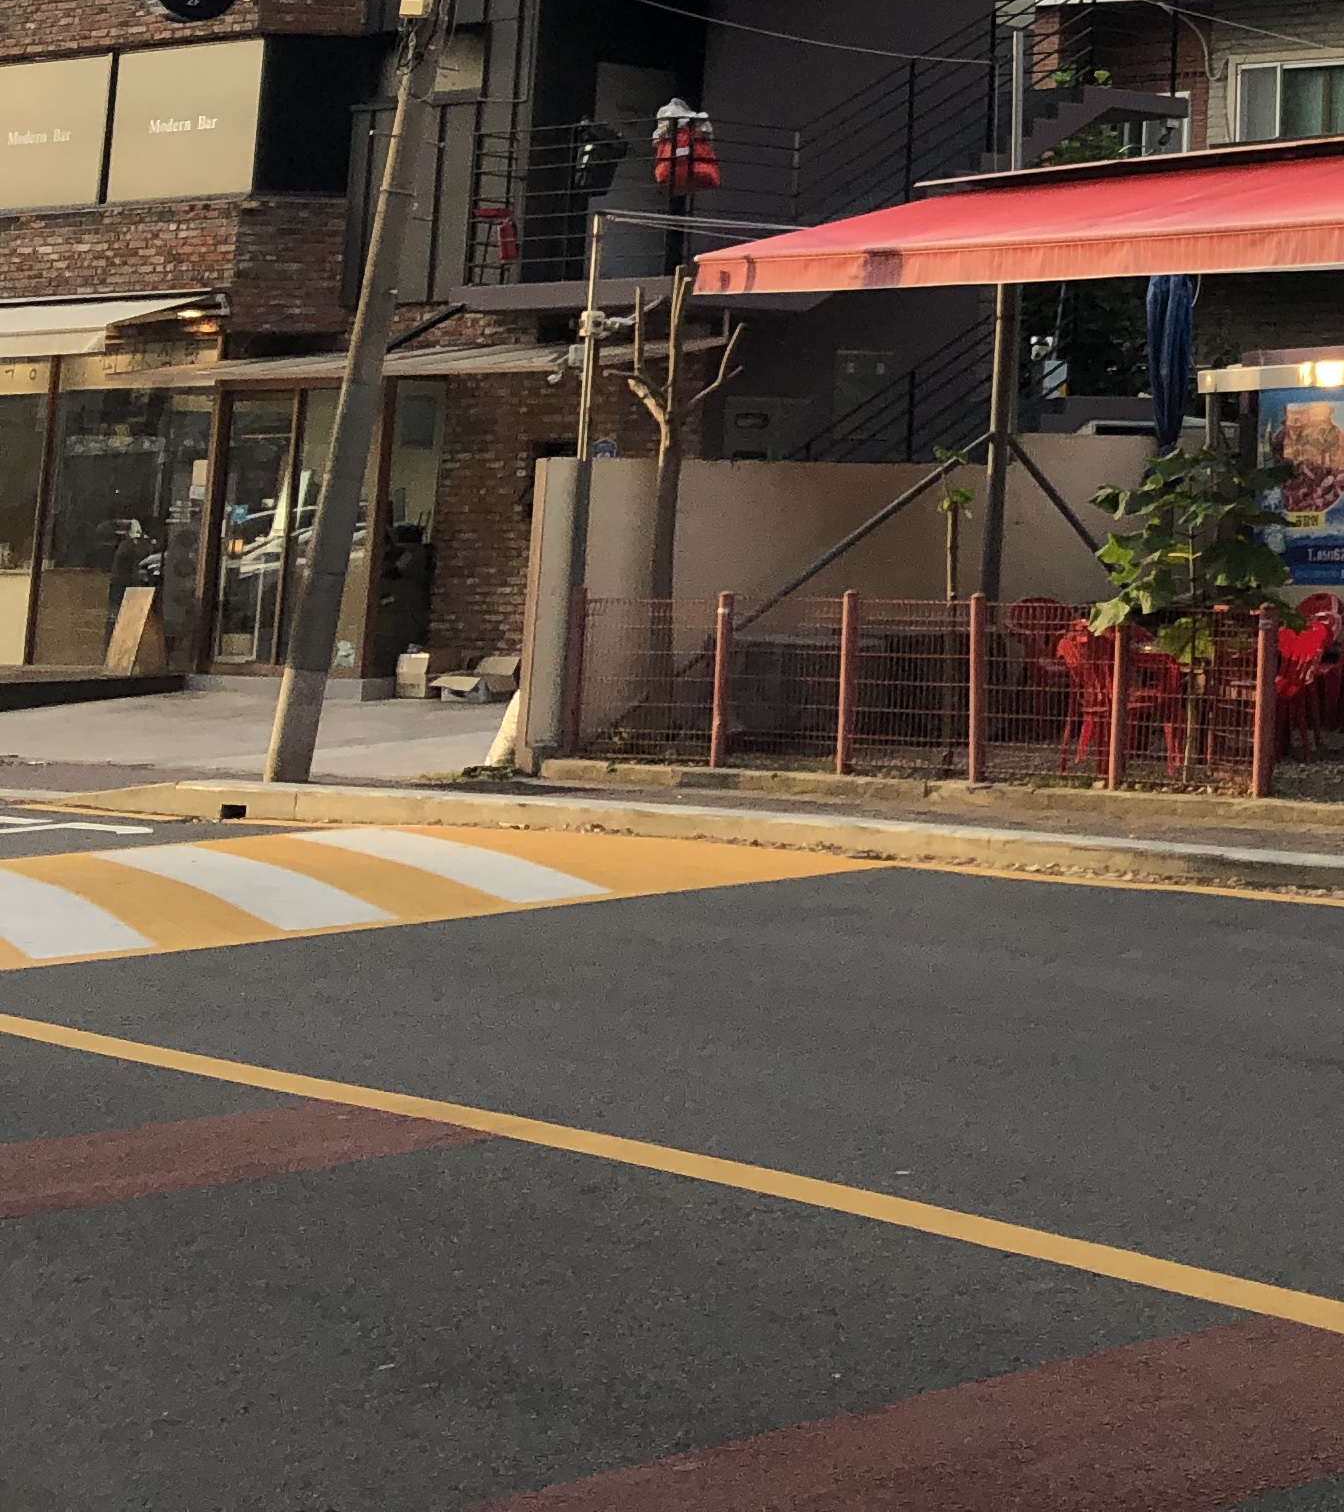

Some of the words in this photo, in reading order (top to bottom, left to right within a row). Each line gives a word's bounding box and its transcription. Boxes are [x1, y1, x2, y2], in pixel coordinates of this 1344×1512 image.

[148, 117, 191, 134] Modern
[198, 115, 217, 130] Bar
[7, 131, 47, 145] Modern
[53, 129, 71, 143] Bar
